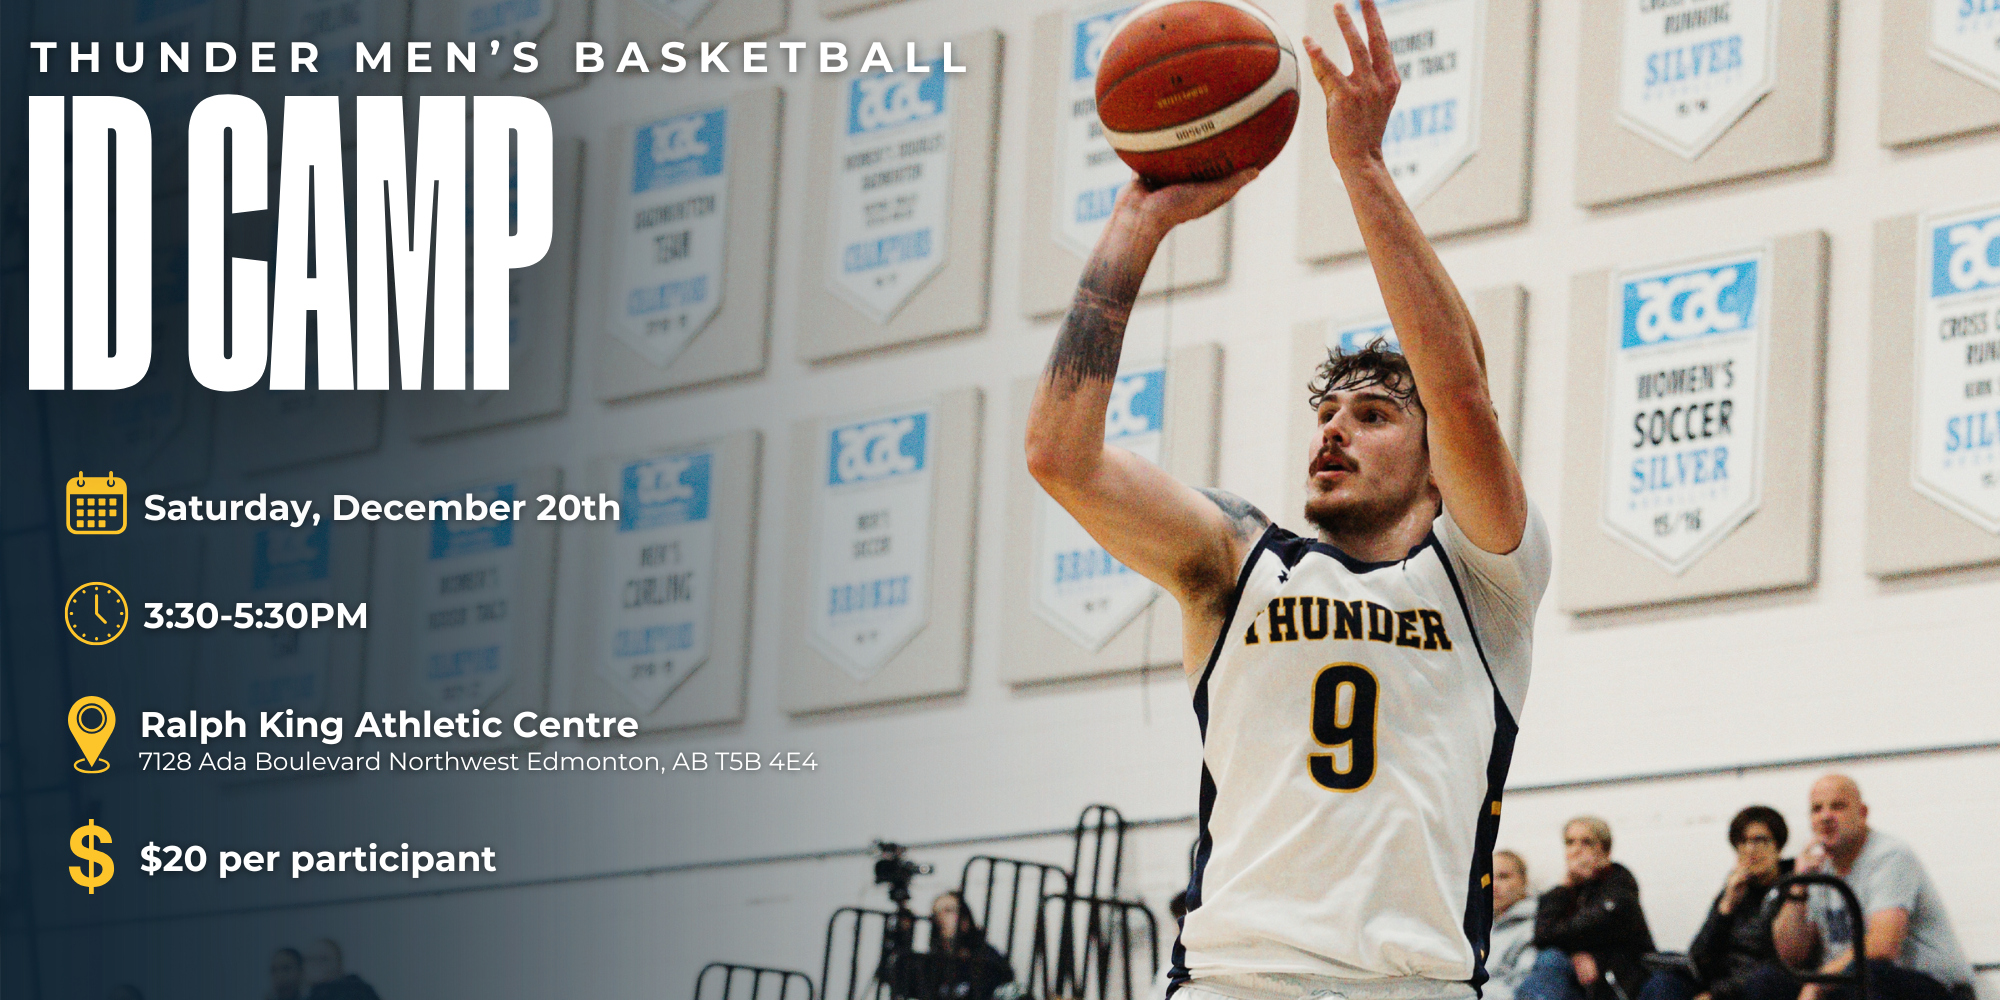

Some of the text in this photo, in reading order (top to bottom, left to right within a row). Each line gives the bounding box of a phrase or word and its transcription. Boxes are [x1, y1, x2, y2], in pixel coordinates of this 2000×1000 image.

[1644, 33, 1743, 87] SILVER
[1637, 358, 1735, 399] WOMEN'S
[1632, 399, 1733, 448] SOCCER
[1630, 445, 1729, 494] SILVER
[1306, 661, 1381, 793] 9
